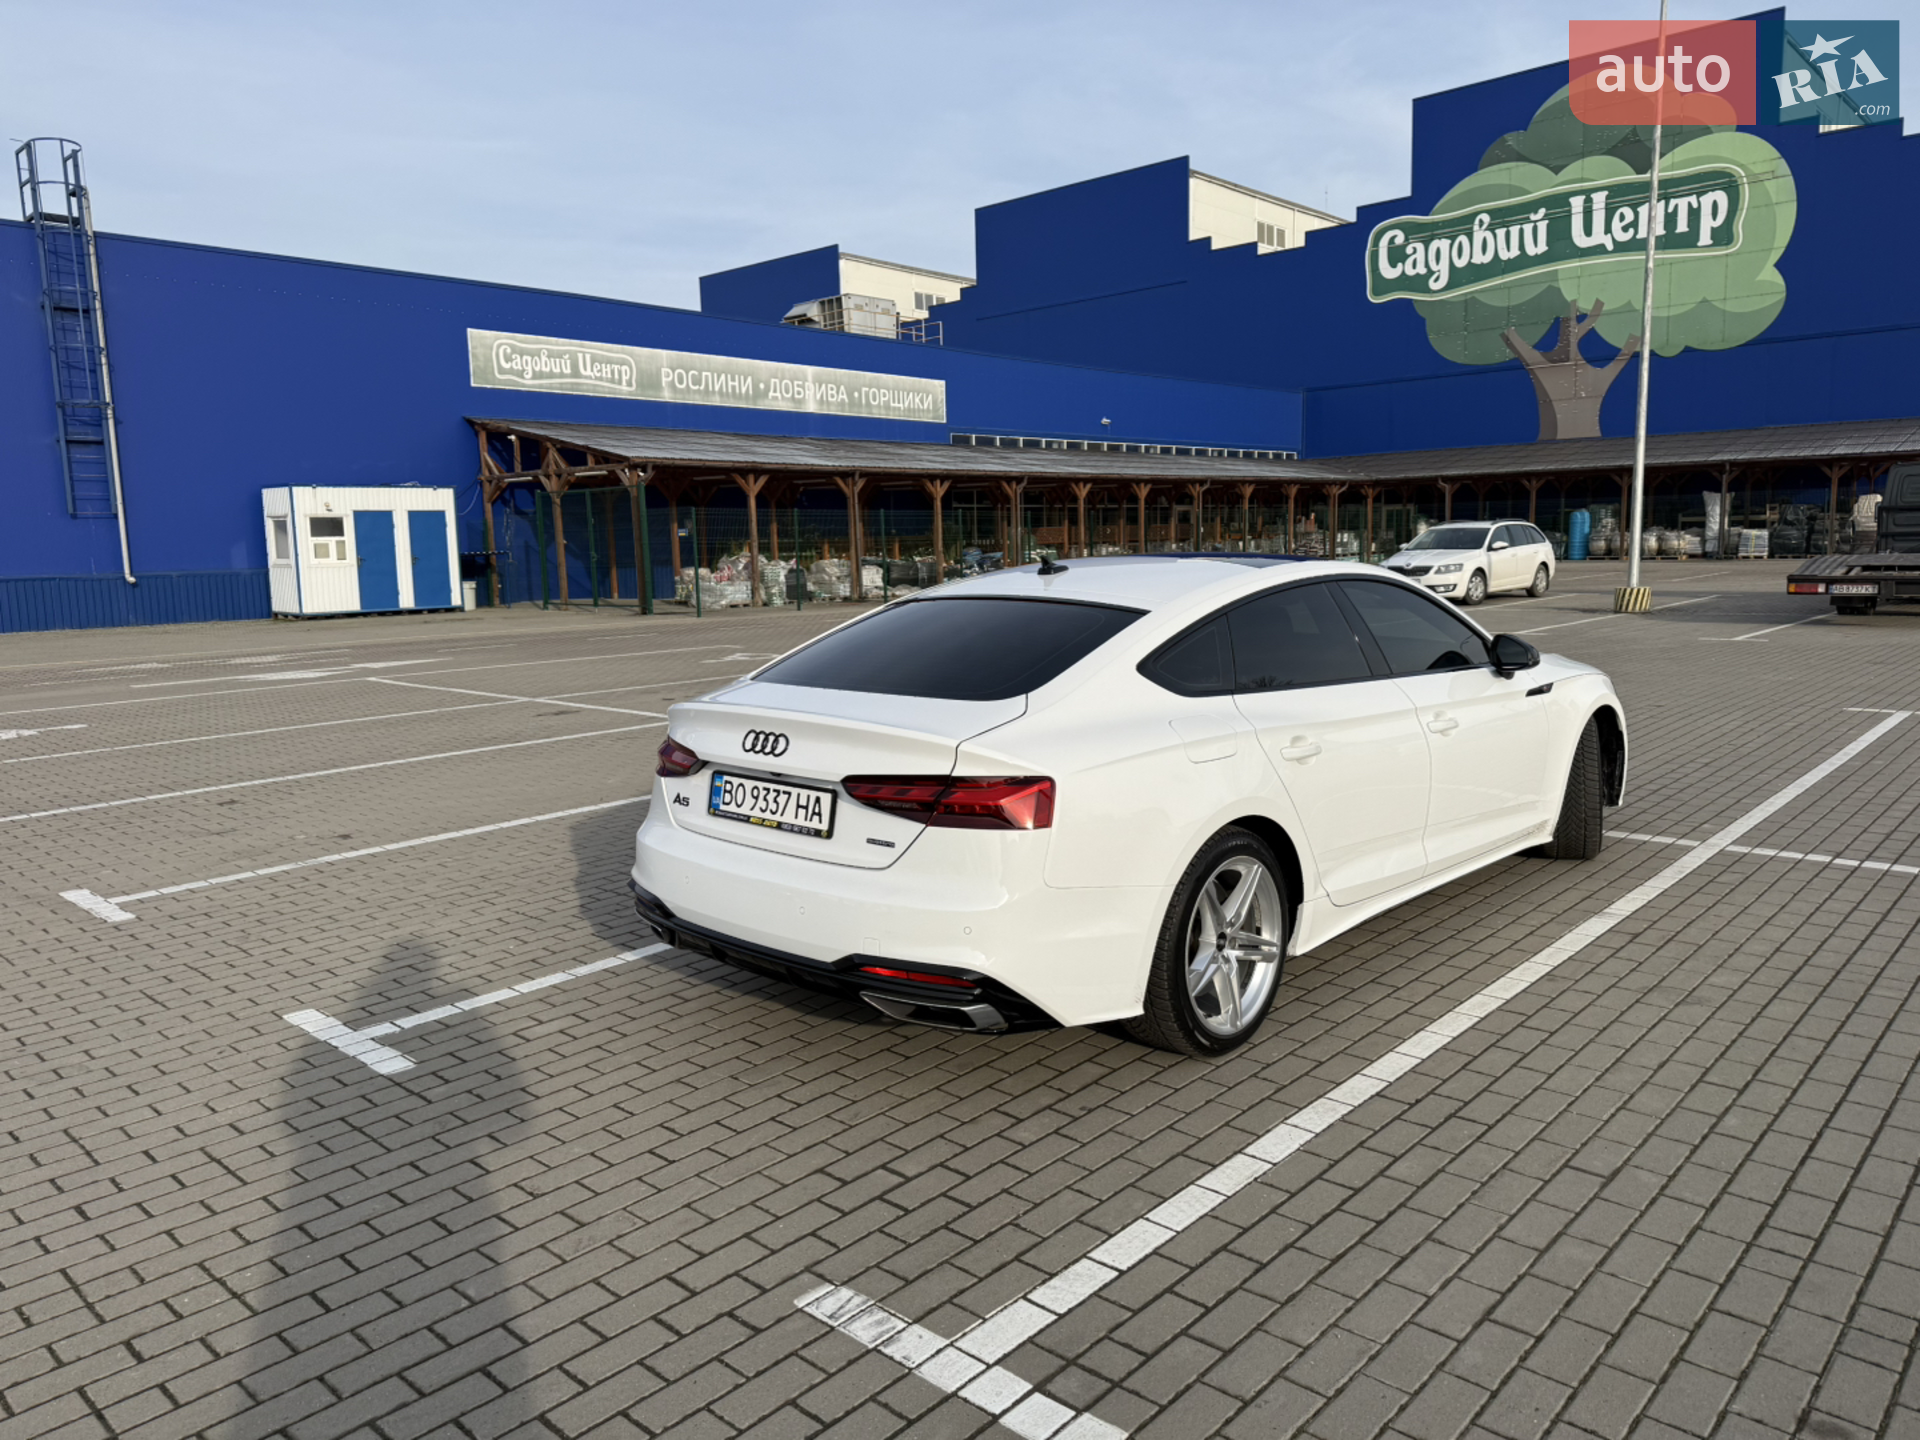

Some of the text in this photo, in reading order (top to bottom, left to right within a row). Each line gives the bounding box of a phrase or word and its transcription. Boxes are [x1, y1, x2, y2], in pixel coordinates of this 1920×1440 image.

[1378, 190, 1729, 290] Садовий Центр
[499, 345, 631, 386] Садовий Центр
[661, 367, 933, 411] РОСЛИНИ ДОБРИВА ГОРЩИКИ
[672, 792, 690, 807] A5
[722, 780, 823, 825] BO 9337 HA
